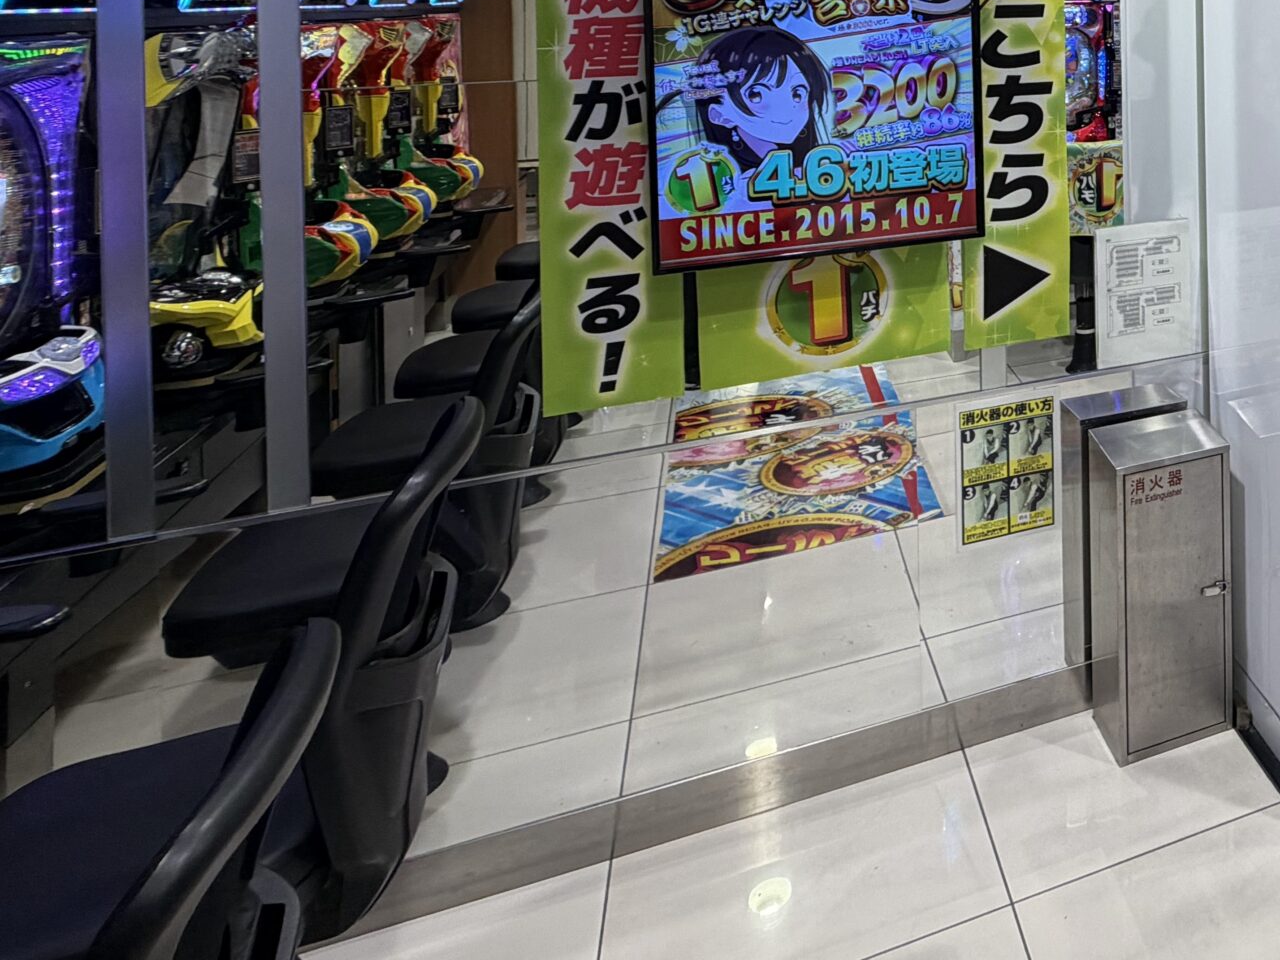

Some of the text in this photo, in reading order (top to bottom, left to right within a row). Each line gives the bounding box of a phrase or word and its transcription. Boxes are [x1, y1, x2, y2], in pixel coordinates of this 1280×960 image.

[680, 192, 963, 252] SINCE.2015.10.7
[860, 290, 877, 321] パチ
[961, 401, 1053, 426] 消火器の使い方
[1010, 422, 1018, 433] 2
[965, 430, 971, 441] 1
[1010, 477, 1019, 489] 4
[1131, 469, 1183, 495] 消火器
[966, 487, 974, 499] 3
[1145, 488, 1183, 503] Extinguisher
